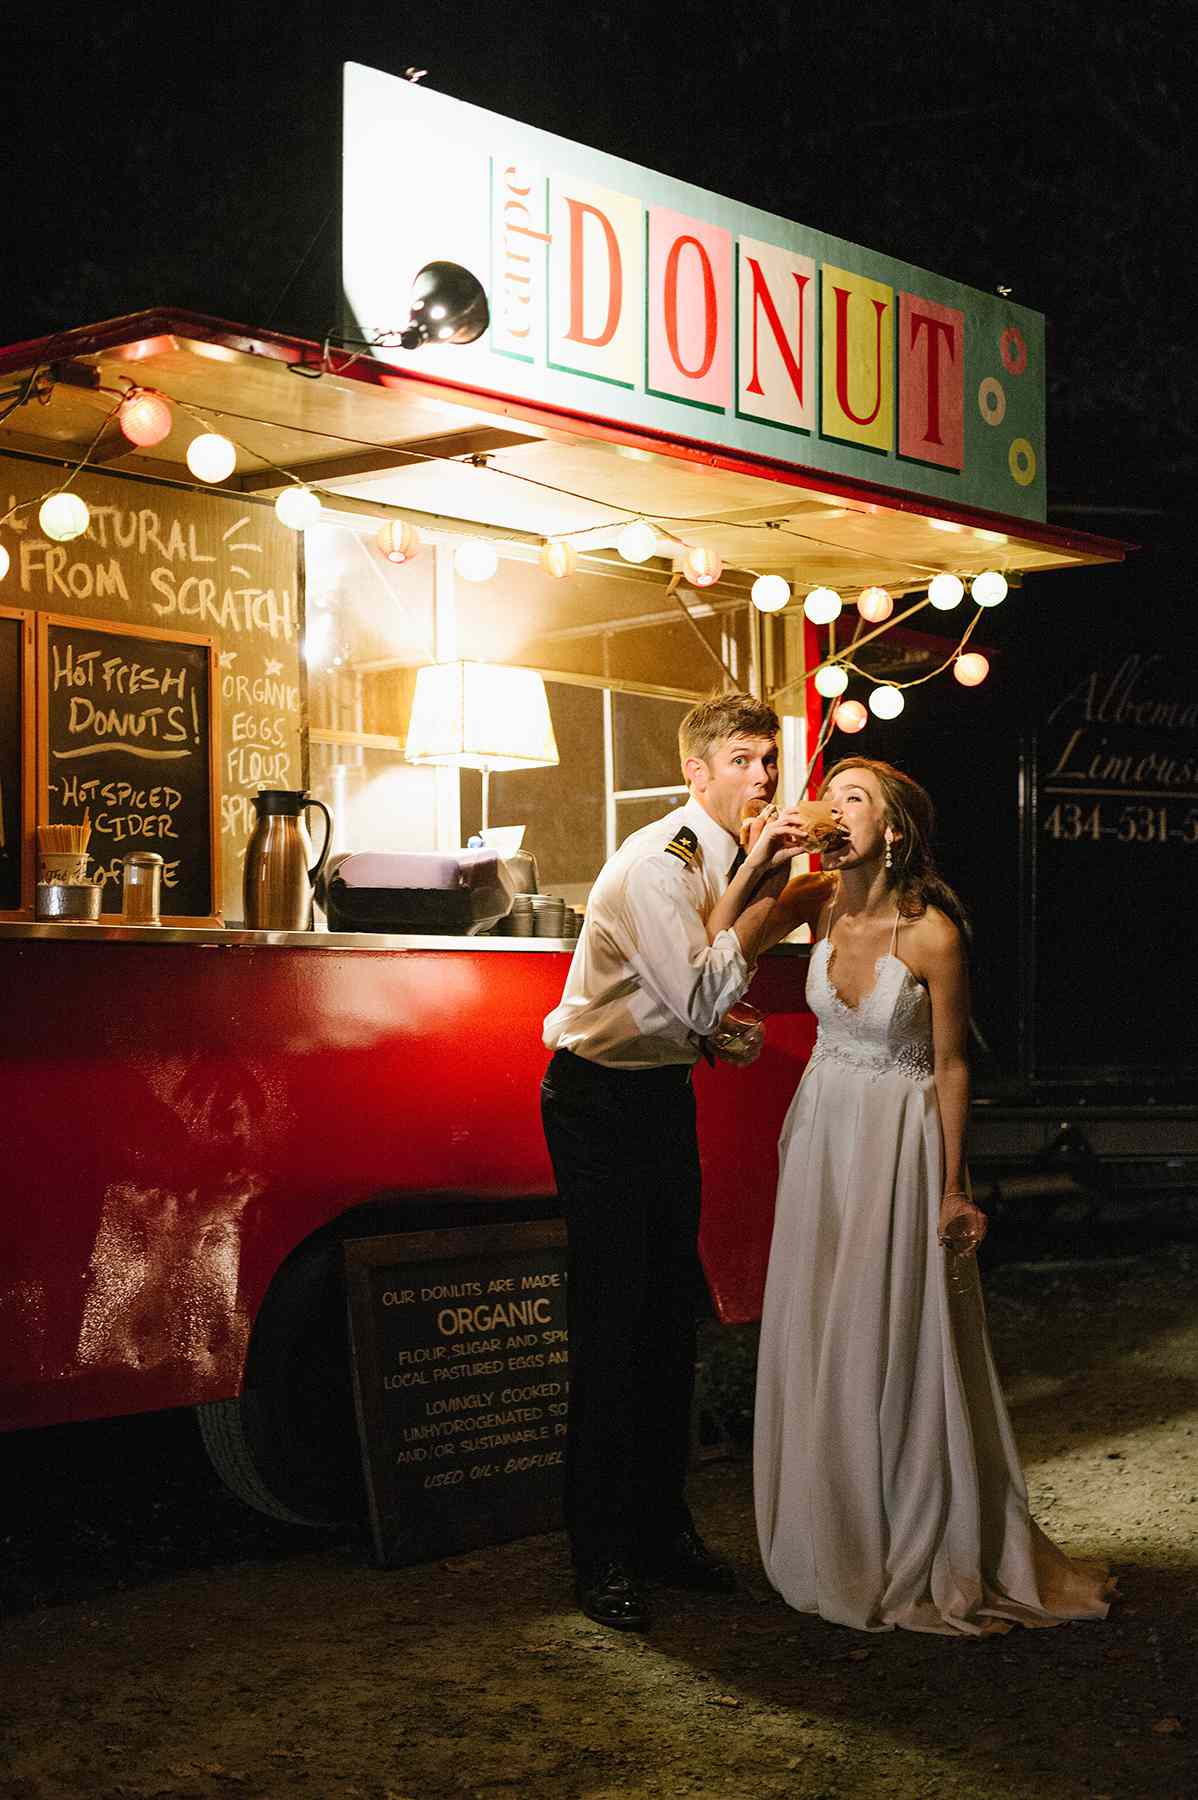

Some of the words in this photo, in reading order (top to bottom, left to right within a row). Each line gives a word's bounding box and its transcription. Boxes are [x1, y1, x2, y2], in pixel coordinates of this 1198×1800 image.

[561, 195, 956, 446] DONUT
[83, 504, 217, 562] TURAL
[19, 540, 130, 600] FROM
[150, 565, 300, 641] SCRATCH!
[221, 674, 300, 712] ORGANIC
[67, 685, 202, 745] DONUTS!
[226, 748, 291, 788] FLOUR
[100, 781, 183, 811] SPICED
[94, 812, 179, 842] CIDER
[382, 1289, 416, 1307] OUR
[421, 1281, 481, 1300] DONUTS
[487, 1278, 515, 1295] ARE
[520, 1272, 561, 1291] MADE
[437, 1297, 553, 1337] ORGANIC
[450, 1339, 500, 1356] SUGAR
[506, 1332, 538, 1350] AND
[383, 1371, 430, 1392] LOCAL
[432, 1359, 503, 1380] PASTURED
[507, 1353, 545, 1372] EGGS
[502, 1383, 561, 1404] COOKED
[424, 1469, 464, 1490] USED
